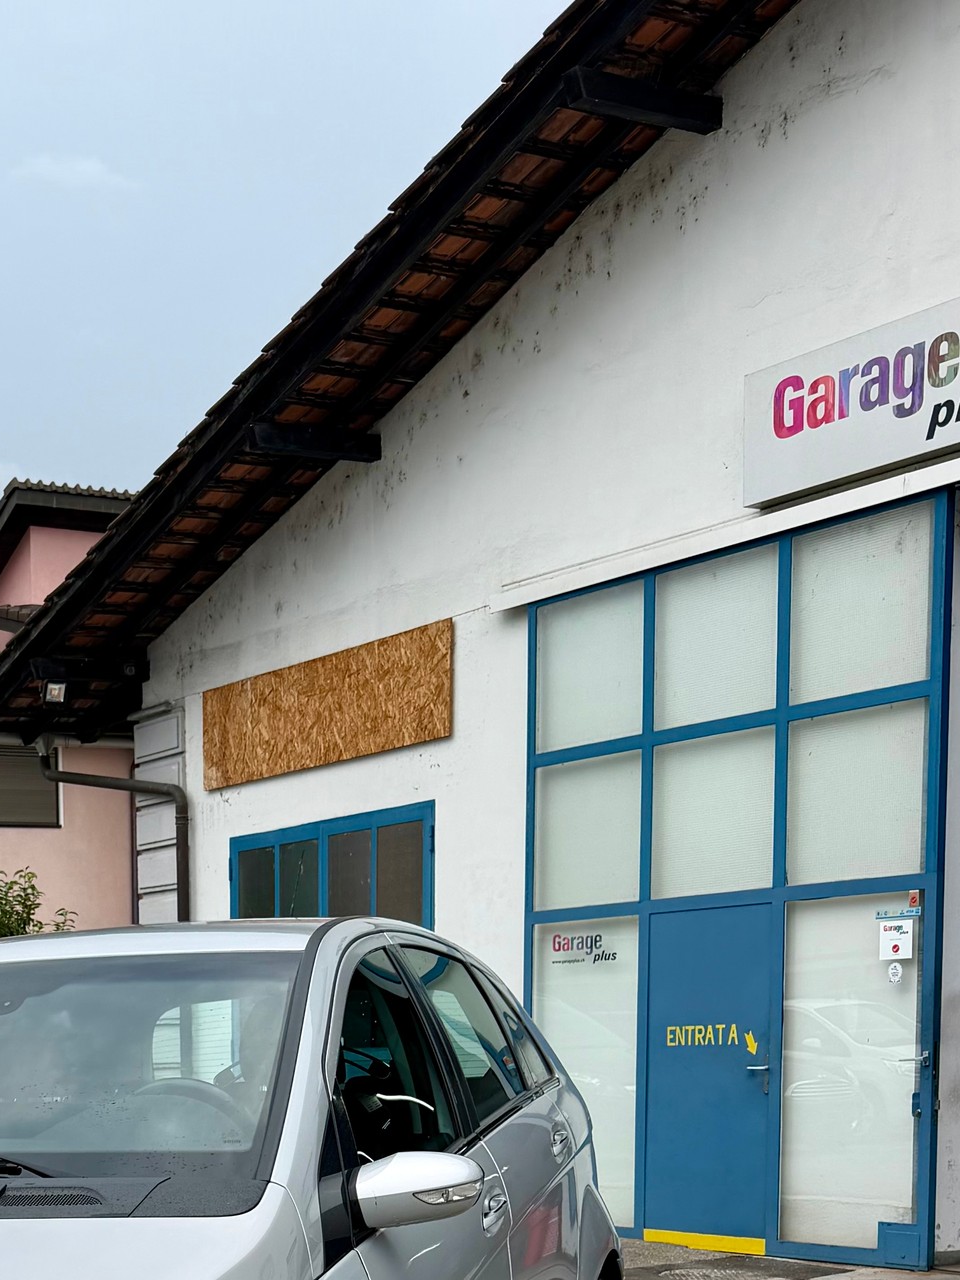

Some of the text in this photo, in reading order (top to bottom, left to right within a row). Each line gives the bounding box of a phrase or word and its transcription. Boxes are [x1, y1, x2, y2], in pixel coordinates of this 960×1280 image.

[773, 331, 959, 439] Garage
[926, 399, 960, 440] p
[552, 933, 603, 956] Garage
[592, 949, 618, 964] plus
[666, 1023, 739, 1047] ENTRATA
